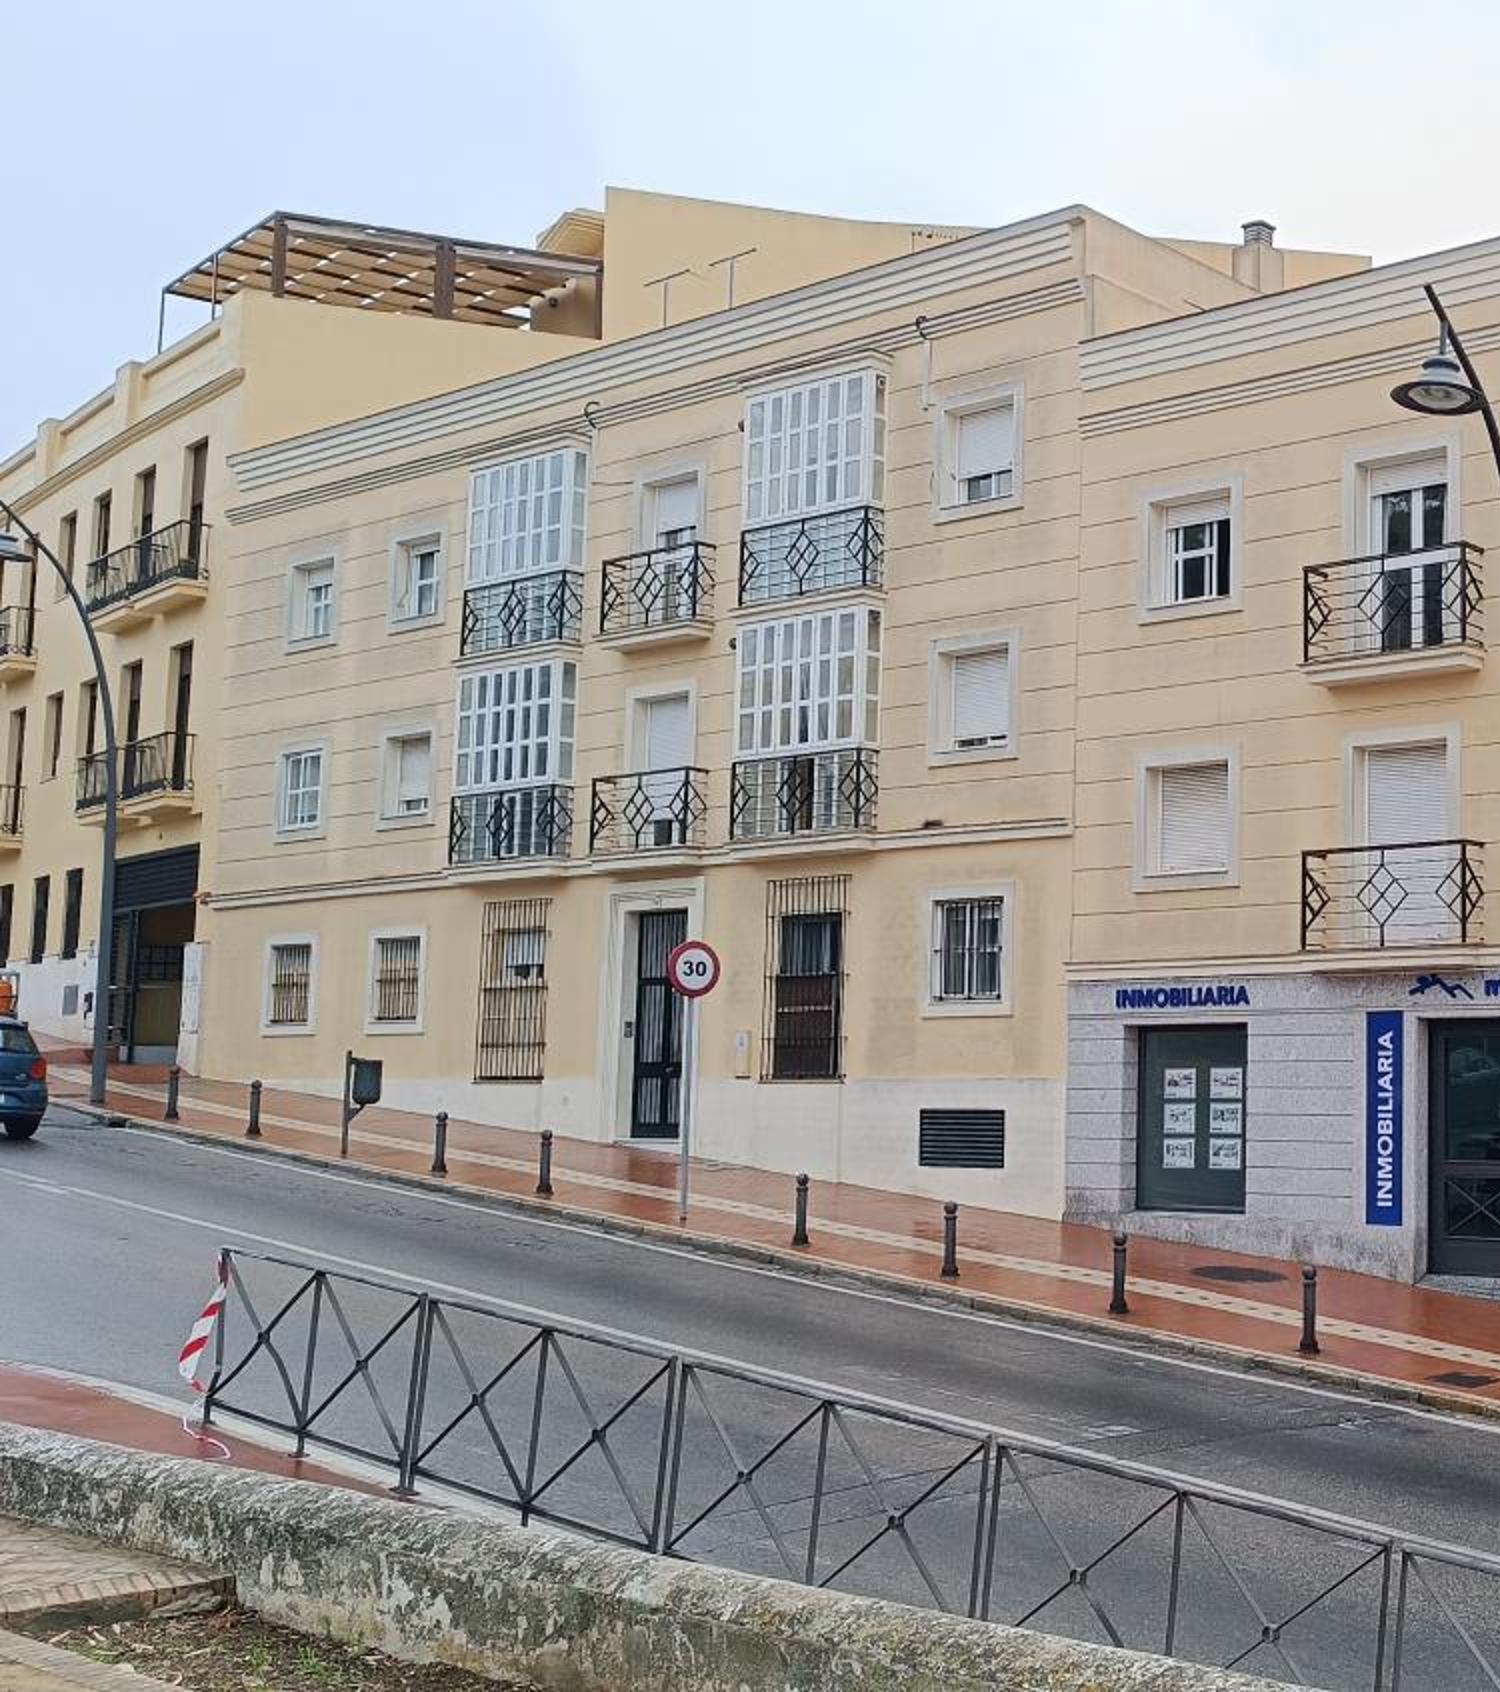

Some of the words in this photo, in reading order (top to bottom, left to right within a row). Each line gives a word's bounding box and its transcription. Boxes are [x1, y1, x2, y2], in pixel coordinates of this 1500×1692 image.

[683, 961, 707, 977] 30
[1115, 985, 1250, 1009] INMOBILIARIA
[1377, 1031, 1393, 1207] INMOBILIARIA
